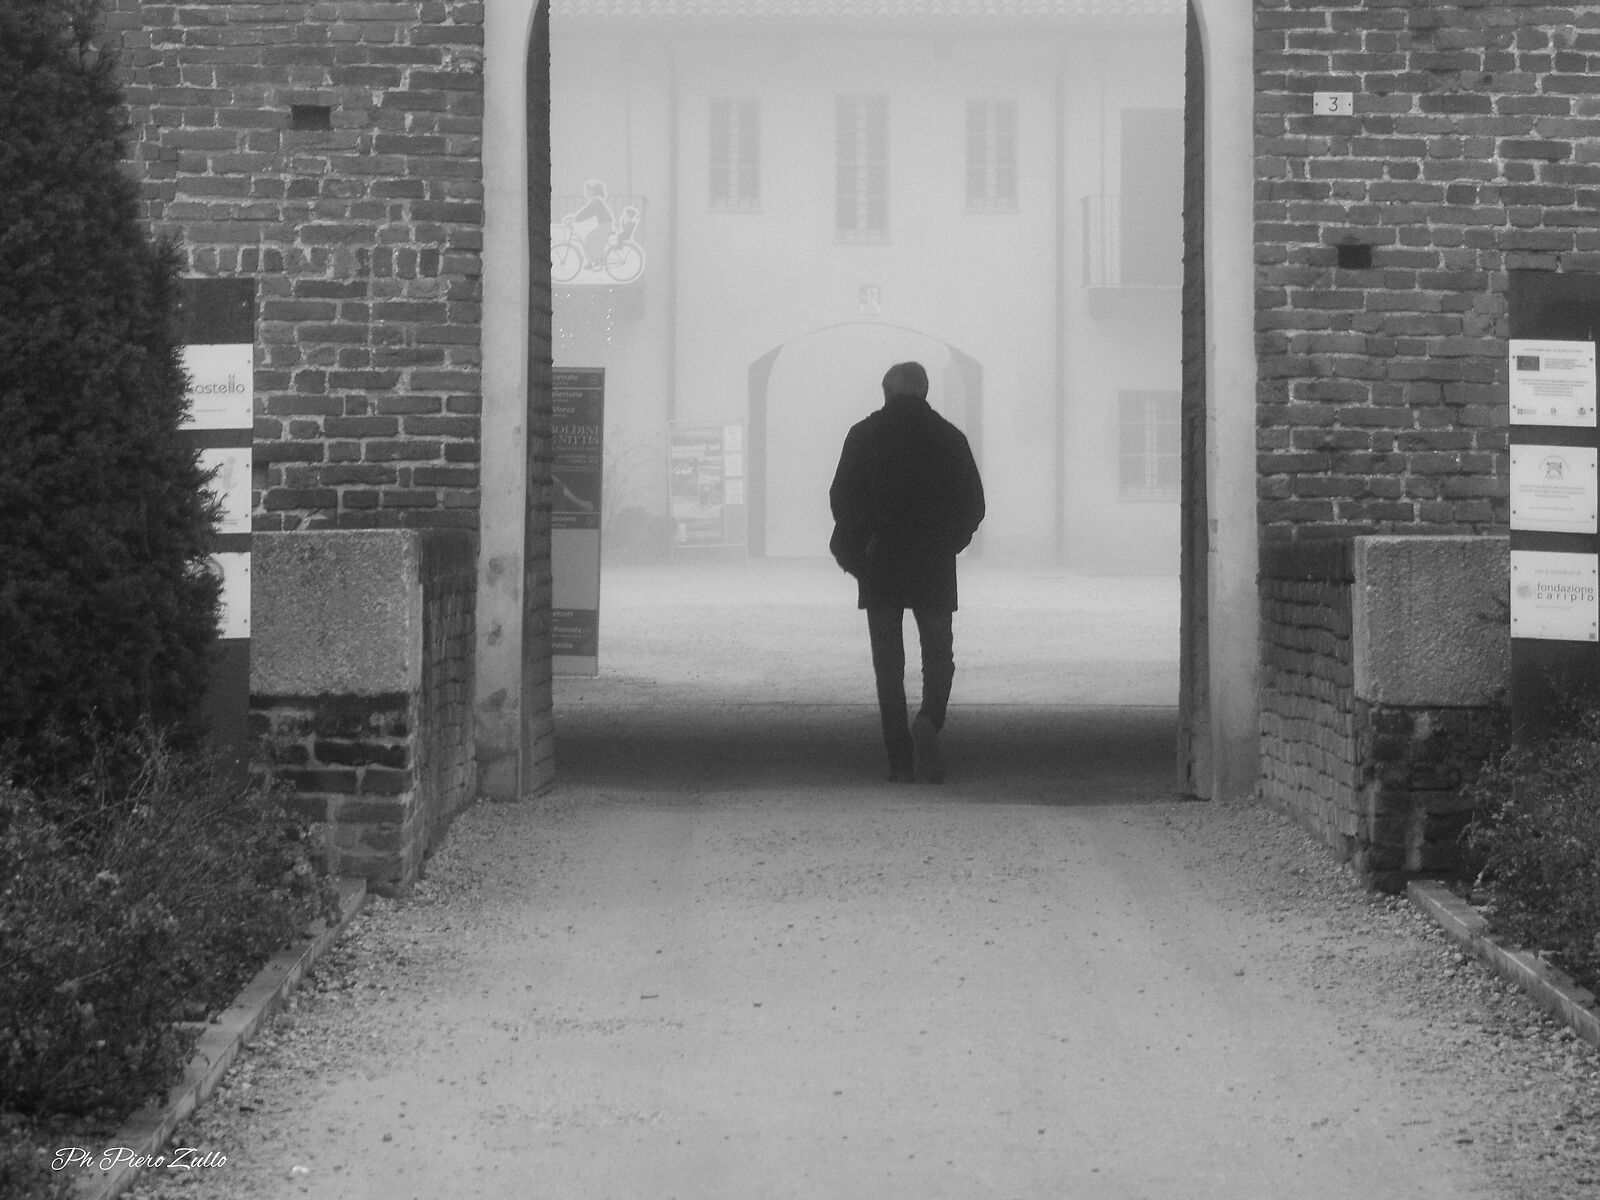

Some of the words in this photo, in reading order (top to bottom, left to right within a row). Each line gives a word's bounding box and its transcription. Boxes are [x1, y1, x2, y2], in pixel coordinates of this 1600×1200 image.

[1328, 96, 1339, 112] 3
[190, 373, 246, 394] astello
[1536, 582, 1594, 594] fondazione
[1536, 591, 1594, 603] cariplo
